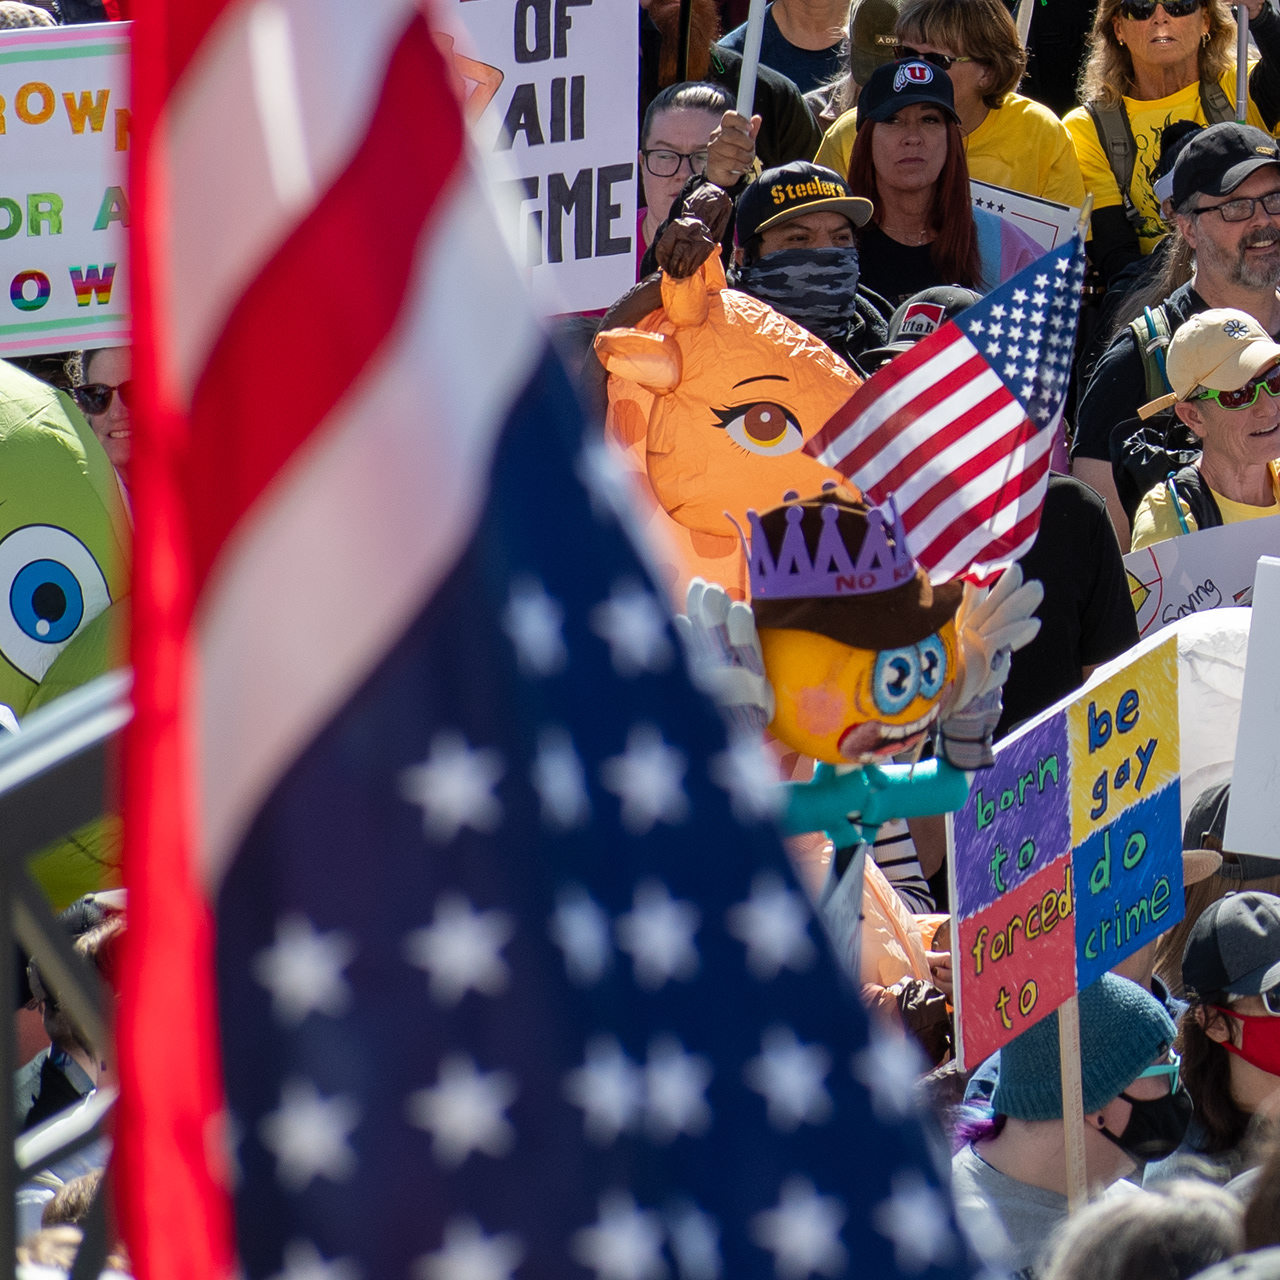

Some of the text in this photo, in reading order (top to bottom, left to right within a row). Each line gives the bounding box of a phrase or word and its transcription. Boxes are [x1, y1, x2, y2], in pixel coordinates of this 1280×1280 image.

[771, 176, 846, 205] Steelers
[1088, 689, 1141, 754] be
[975, 754, 1059, 831] born
[1091, 738, 1158, 821] gay
[990, 838, 1036, 893] to
[1089, 826, 1147, 895] do
[972, 865, 1074, 975] forced
[1084, 876, 1171, 961] crime
[996, 979, 1038, 1030] to
